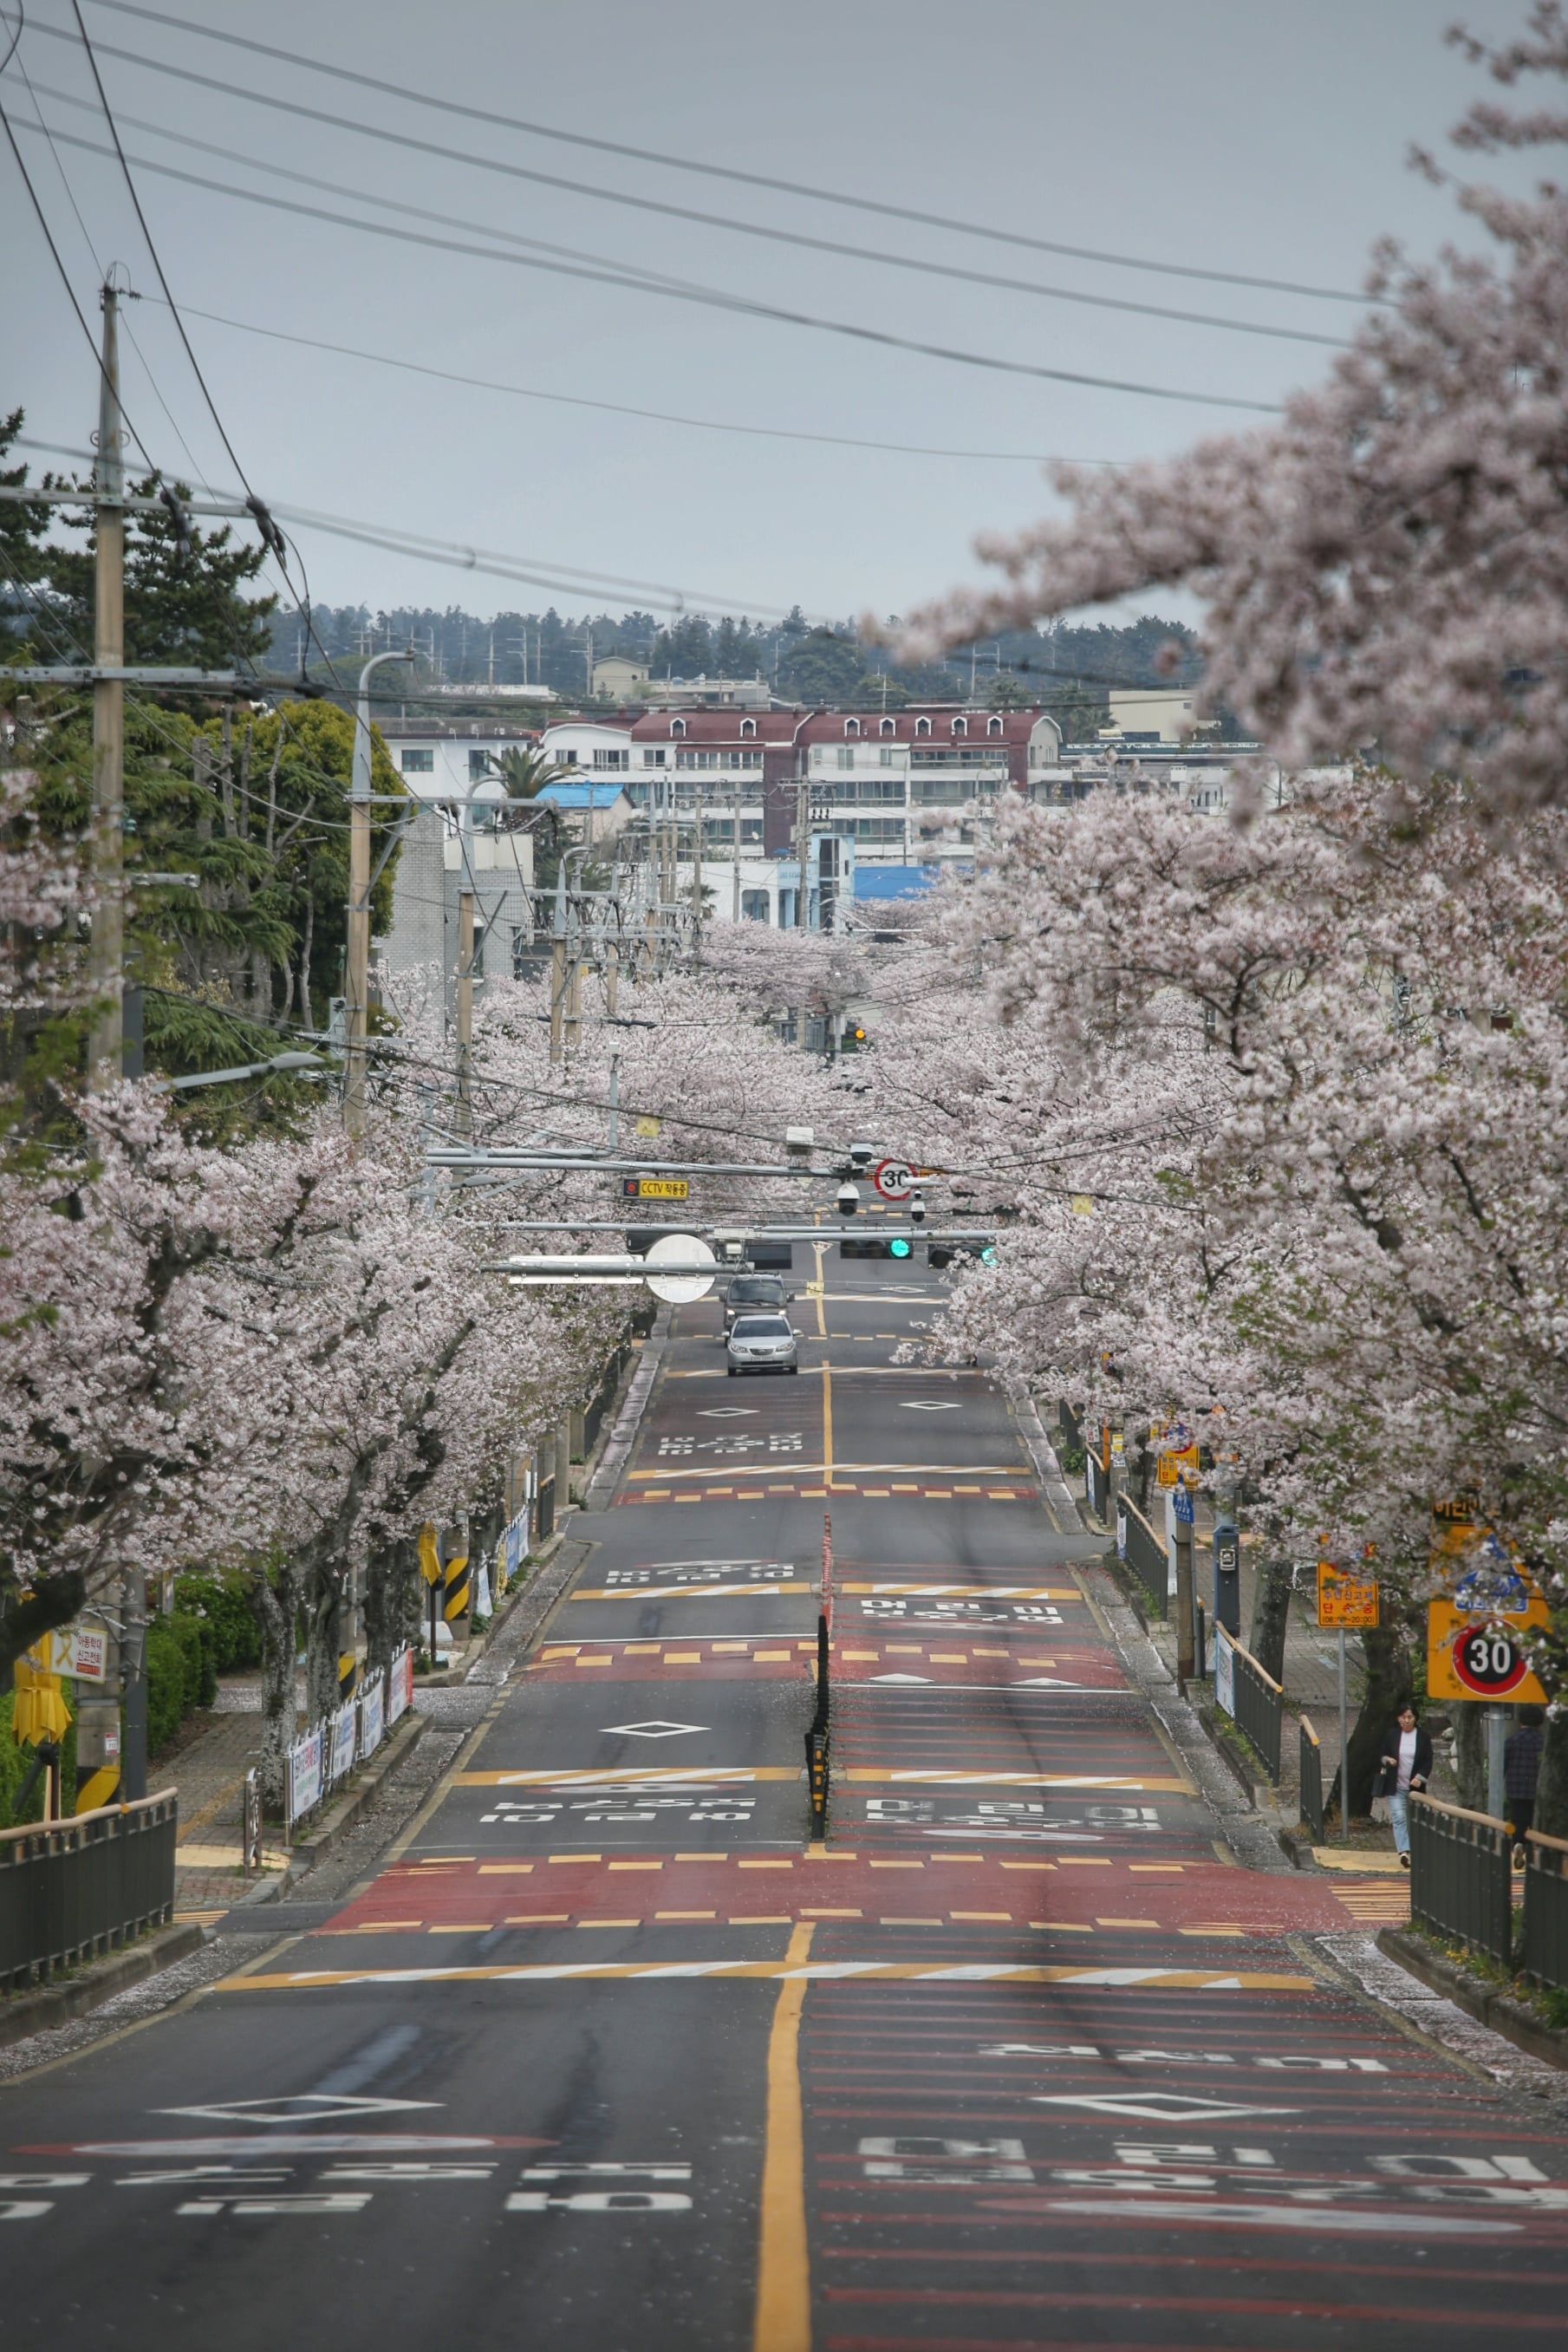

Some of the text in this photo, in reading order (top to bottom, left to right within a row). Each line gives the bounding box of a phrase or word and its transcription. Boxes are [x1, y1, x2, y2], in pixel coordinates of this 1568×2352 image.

[641, 1183, 686, 1196] CCTV 작동중
[861, 1600, 1058, 1614] 어린이
[863, 1609, 1064, 1624] 보호구역
[1470, 1639, 1511, 1674] 30
[494, 1798, 757, 1810] 보호구역
[865, 1799, 1159, 1821] 어린이
[478, 1813, 751, 1823] 어린이
[865, 1813, 1162, 1831] 보호구역
[857, 2136, 1550, 2181] 어린이
